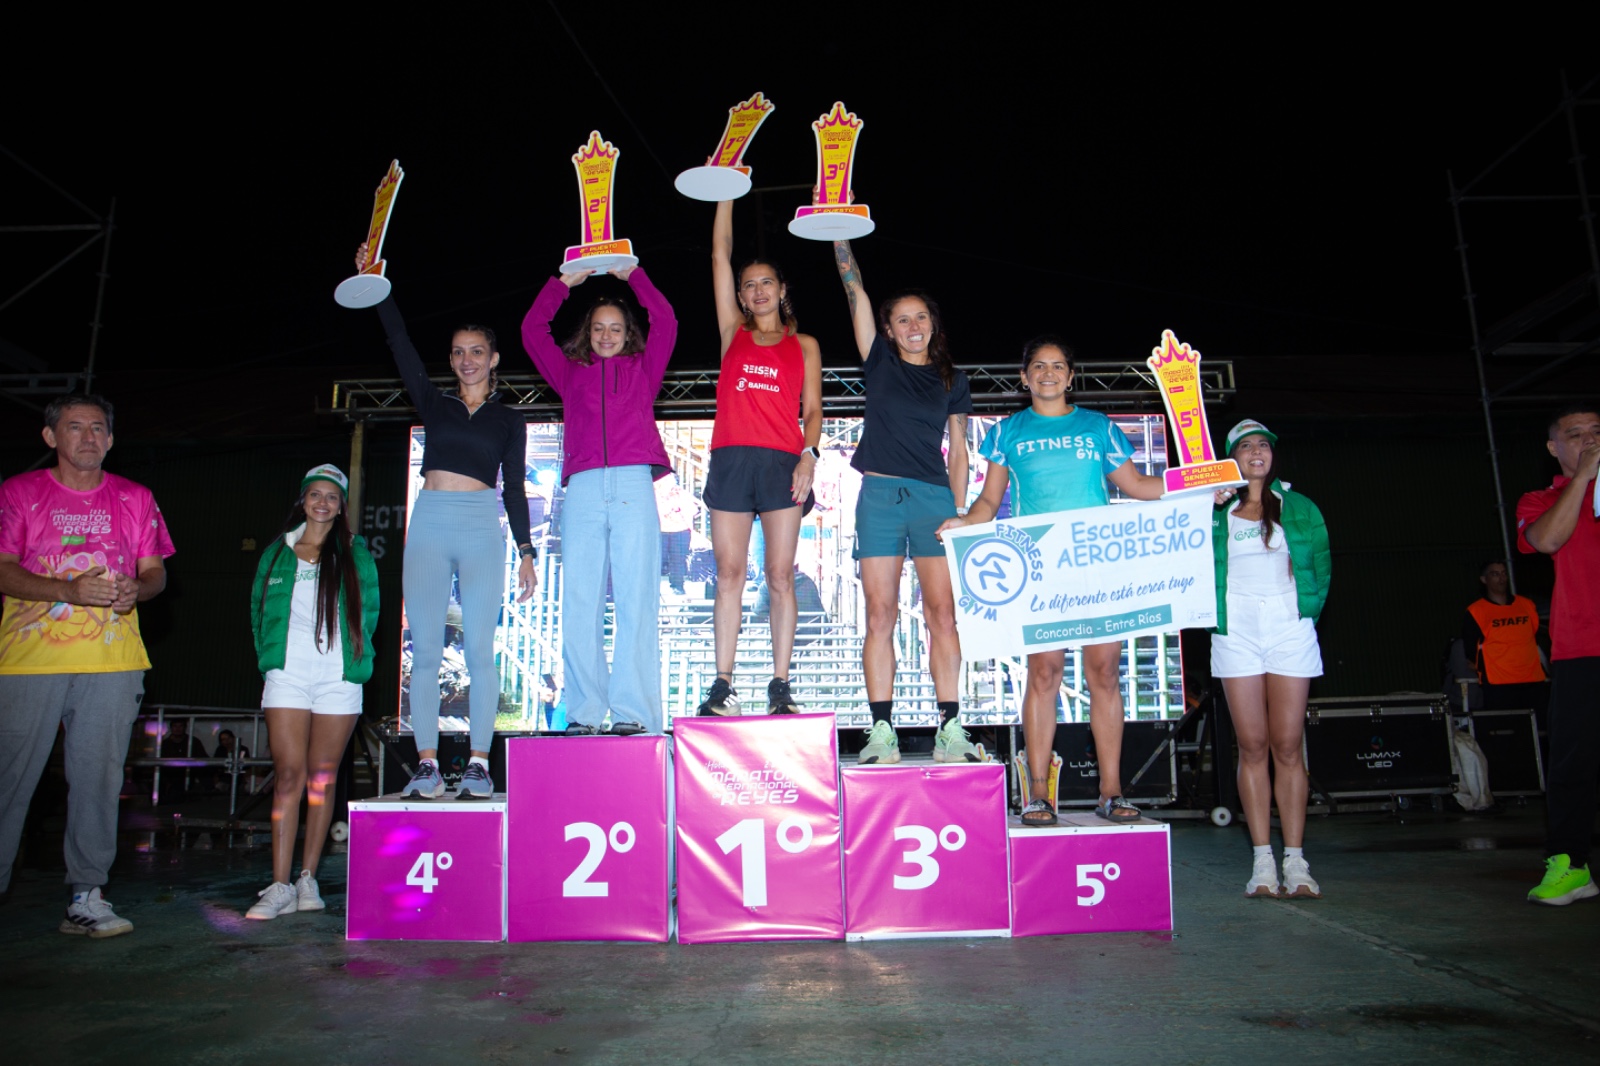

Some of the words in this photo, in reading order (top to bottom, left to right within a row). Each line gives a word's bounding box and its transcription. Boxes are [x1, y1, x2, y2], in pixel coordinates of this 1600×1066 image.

[742, 364, 778, 378] REISEN
[748, 381, 780, 393] BAHILLO
[1016, 435, 1095, 456] FITNESS
[1076, 448, 1101, 462] GYM
[1192, 464, 1223, 475] PUESTO
[1184, 472, 1220, 482] GENERAL
[63, 525, 111, 535] REYES
[1070, 512, 1156, 544] Escuela
[1163, 507, 1190, 530] de
[995, 523, 1044, 582] FITNESS
[1057, 528, 1206, 569] AEROBISMO
[1049, 589, 1108, 614] diferente
[1110, 582, 1135, 602] está
[1136, 579, 1166, 596] cerca
[1168, 575, 1195, 594] tuyo
[958, 595, 997, 622] GYM
[1035, 623, 1093, 640] Concordia
[1105, 617, 1136, 633] Entre
[1138, 611, 1162, 626] Ríos
[1492, 615, 1530, 628] STAFF
[1356, 751, 1402, 760] LUMAX
[1069, 760, 1098, 769] LUM
[1367, 760, 1393, 769] LED
[1080, 769, 1098, 777] LE
[720, 789, 800, 806] REYES
